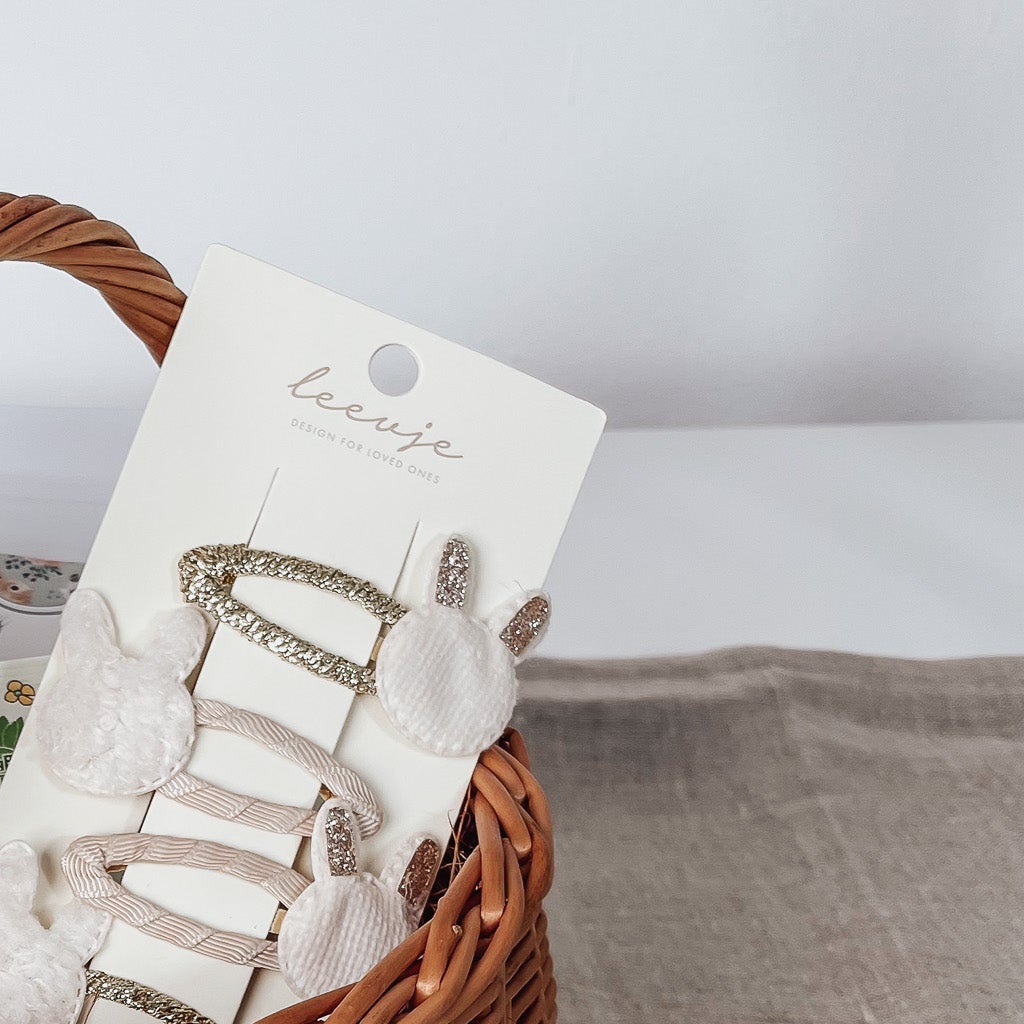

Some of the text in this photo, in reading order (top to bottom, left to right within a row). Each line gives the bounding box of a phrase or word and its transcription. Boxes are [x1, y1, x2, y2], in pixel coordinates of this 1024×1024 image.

[290, 417, 441, 485] DESIGN FOR LOVED ONES
